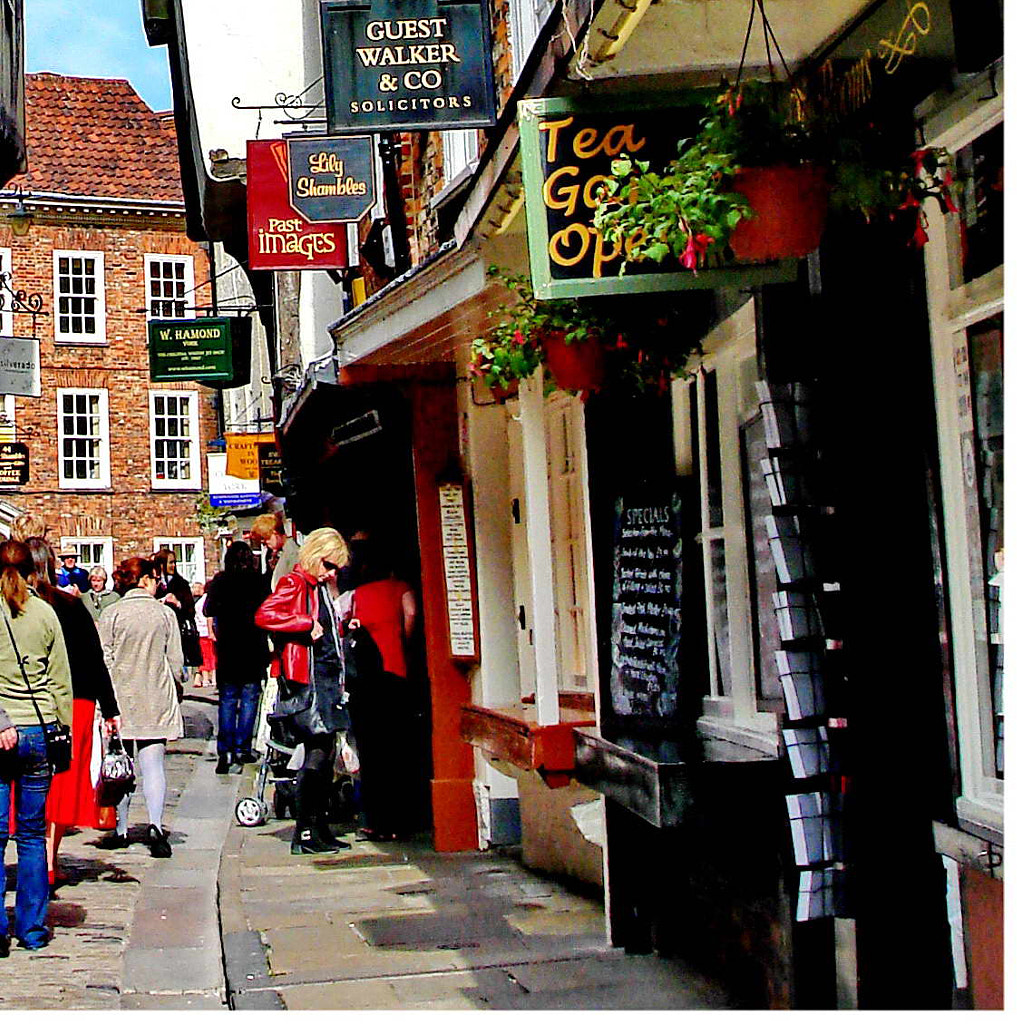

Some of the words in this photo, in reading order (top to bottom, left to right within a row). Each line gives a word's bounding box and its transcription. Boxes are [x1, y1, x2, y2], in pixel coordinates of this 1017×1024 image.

[366, 17, 447, 42] GUEST
[356, 43, 461, 67] WALKER
[378, 73, 399, 92] &
[403, 70, 443, 91] CO
[349, 94, 473, 114] SOLICITORS
[539, 117, 646, 163] Tea
[308, 152, 345, 178] Lily
[296, 177, 367, 199] Shambles
[268, 218, 303, 234] Past
[258, 228, 336, 260] images
[549, 222, 652, 279] Ope
[159, 328, 173, 341] W.
[175, 328, 221, 340] HAMOND
[626, 506, 669, 525] SPECIALS
